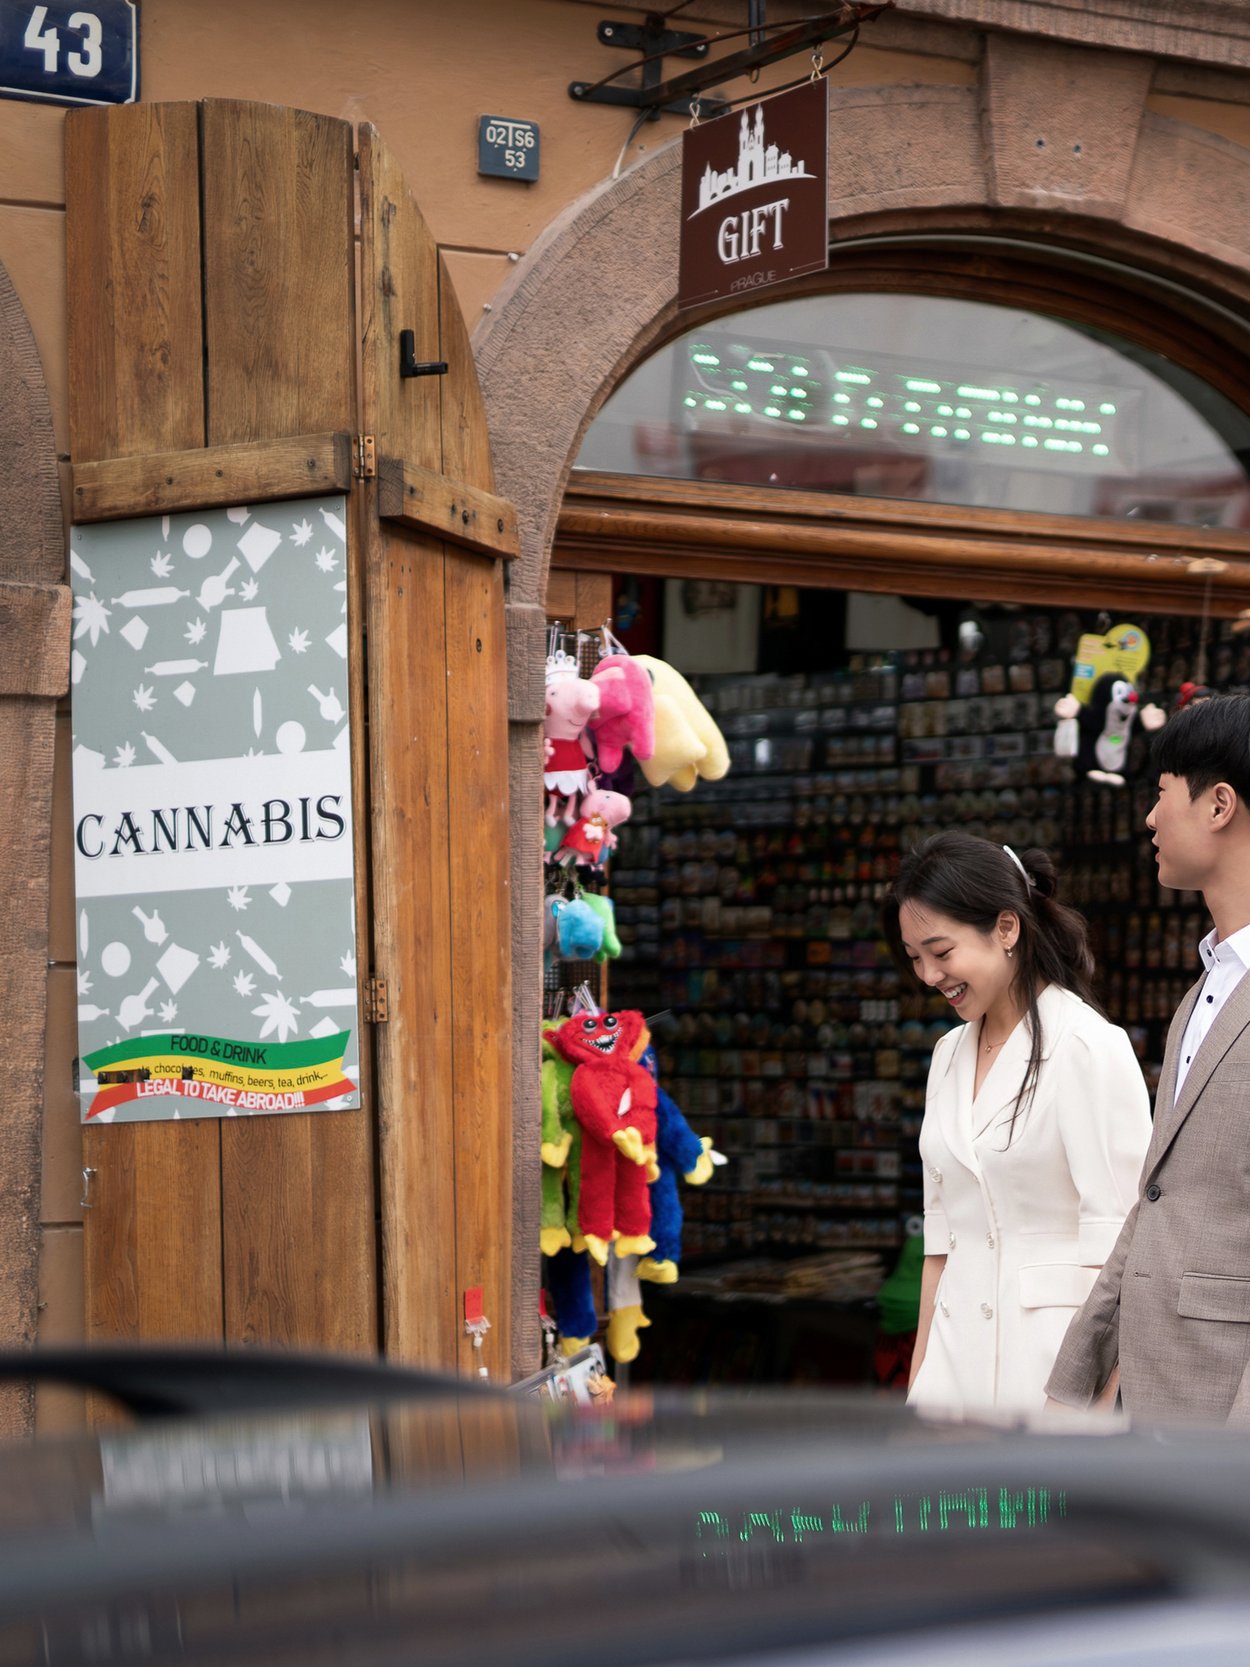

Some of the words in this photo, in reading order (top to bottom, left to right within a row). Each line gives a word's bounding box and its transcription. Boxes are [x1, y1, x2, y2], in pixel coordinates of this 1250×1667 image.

[25, 5, 102, 77] 43
[718, 198, 790, 265] GIFT
[730, 270, 776, 292] PRAGUE
[76, 794, 347, 860] CANNABIS
[171, 1034, 208, 1054] FOOD
[210, 1040, 220, 1057] &
[223, 1043, 268, 1065] DRINK
[136, 1079, 182, 1098] LEGAL
[181, 1080, 201, 1097] TO
[201, 1082, 237, 1106] TAKE
[236, 1090, 306, 1111] ABROAD!!!
[209, 1069, 246, 1087] muffins,
[247, 1075, 276, 1090] beers,
[278, 1077, 295, 1088] tea,
